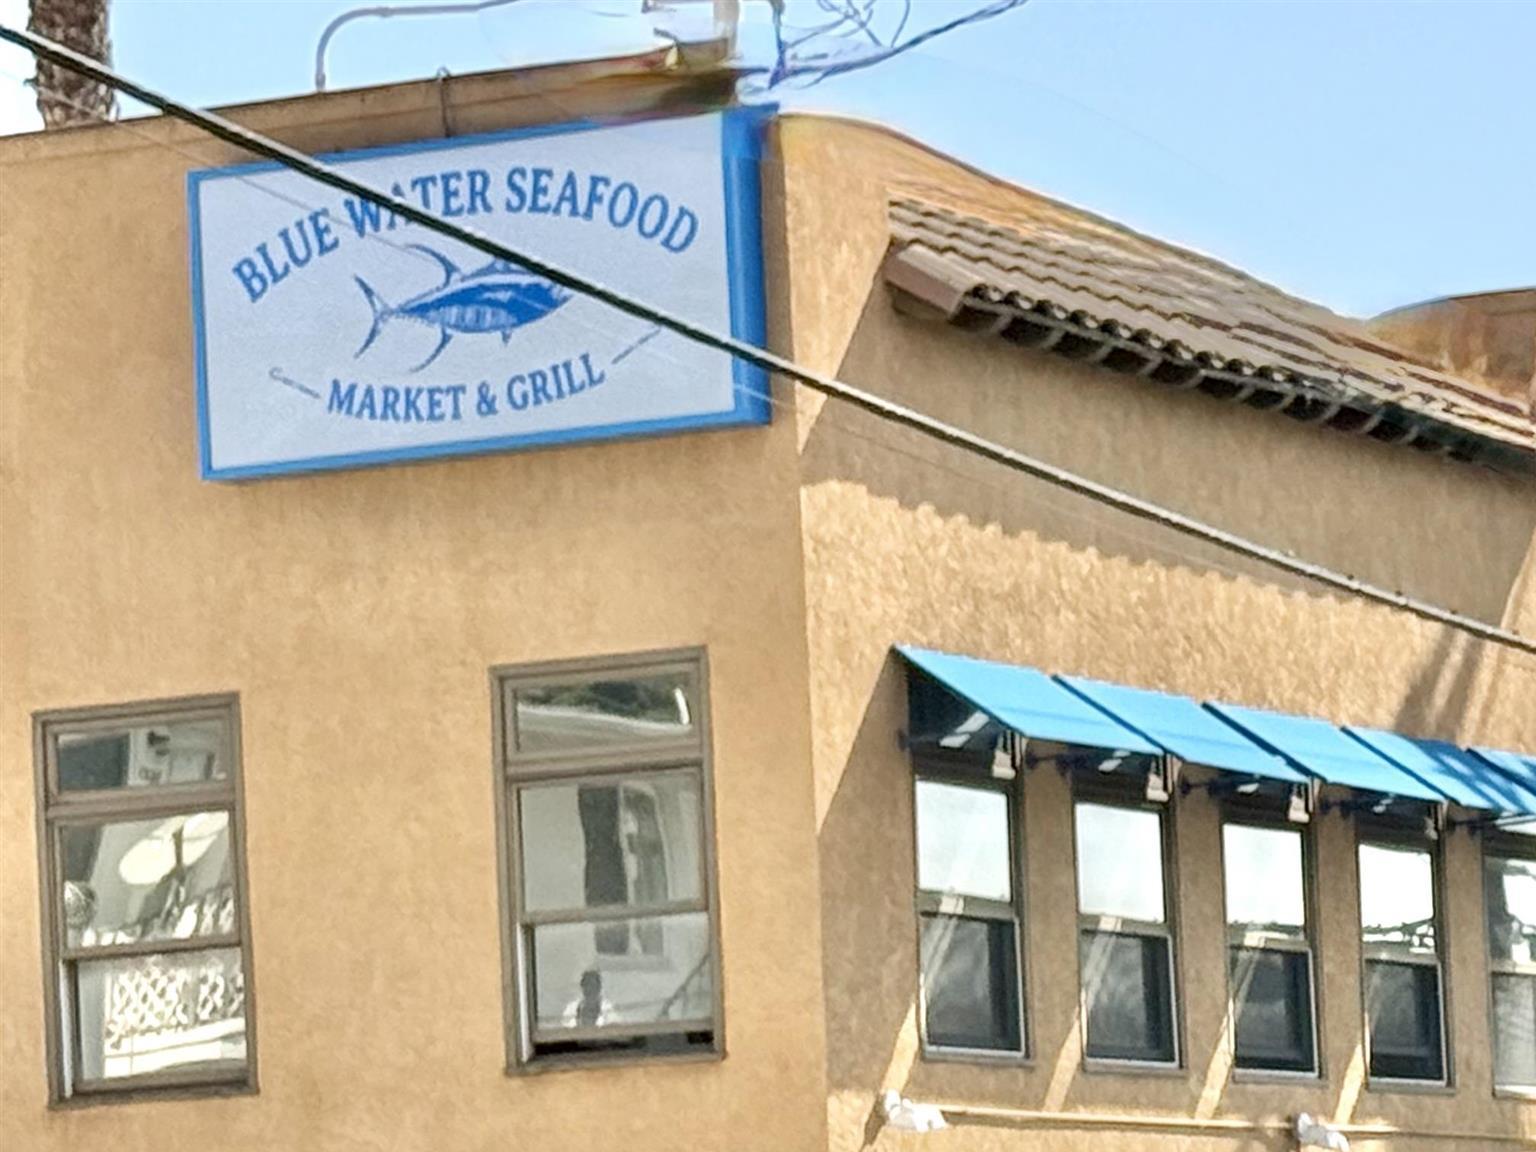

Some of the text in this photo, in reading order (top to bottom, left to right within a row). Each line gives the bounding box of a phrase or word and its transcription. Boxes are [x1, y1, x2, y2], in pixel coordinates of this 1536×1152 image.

[232, 166, 700, 303] BLUE WATER SEAFOOD
[327, 353, 606, 422] MARKET & GRILL
